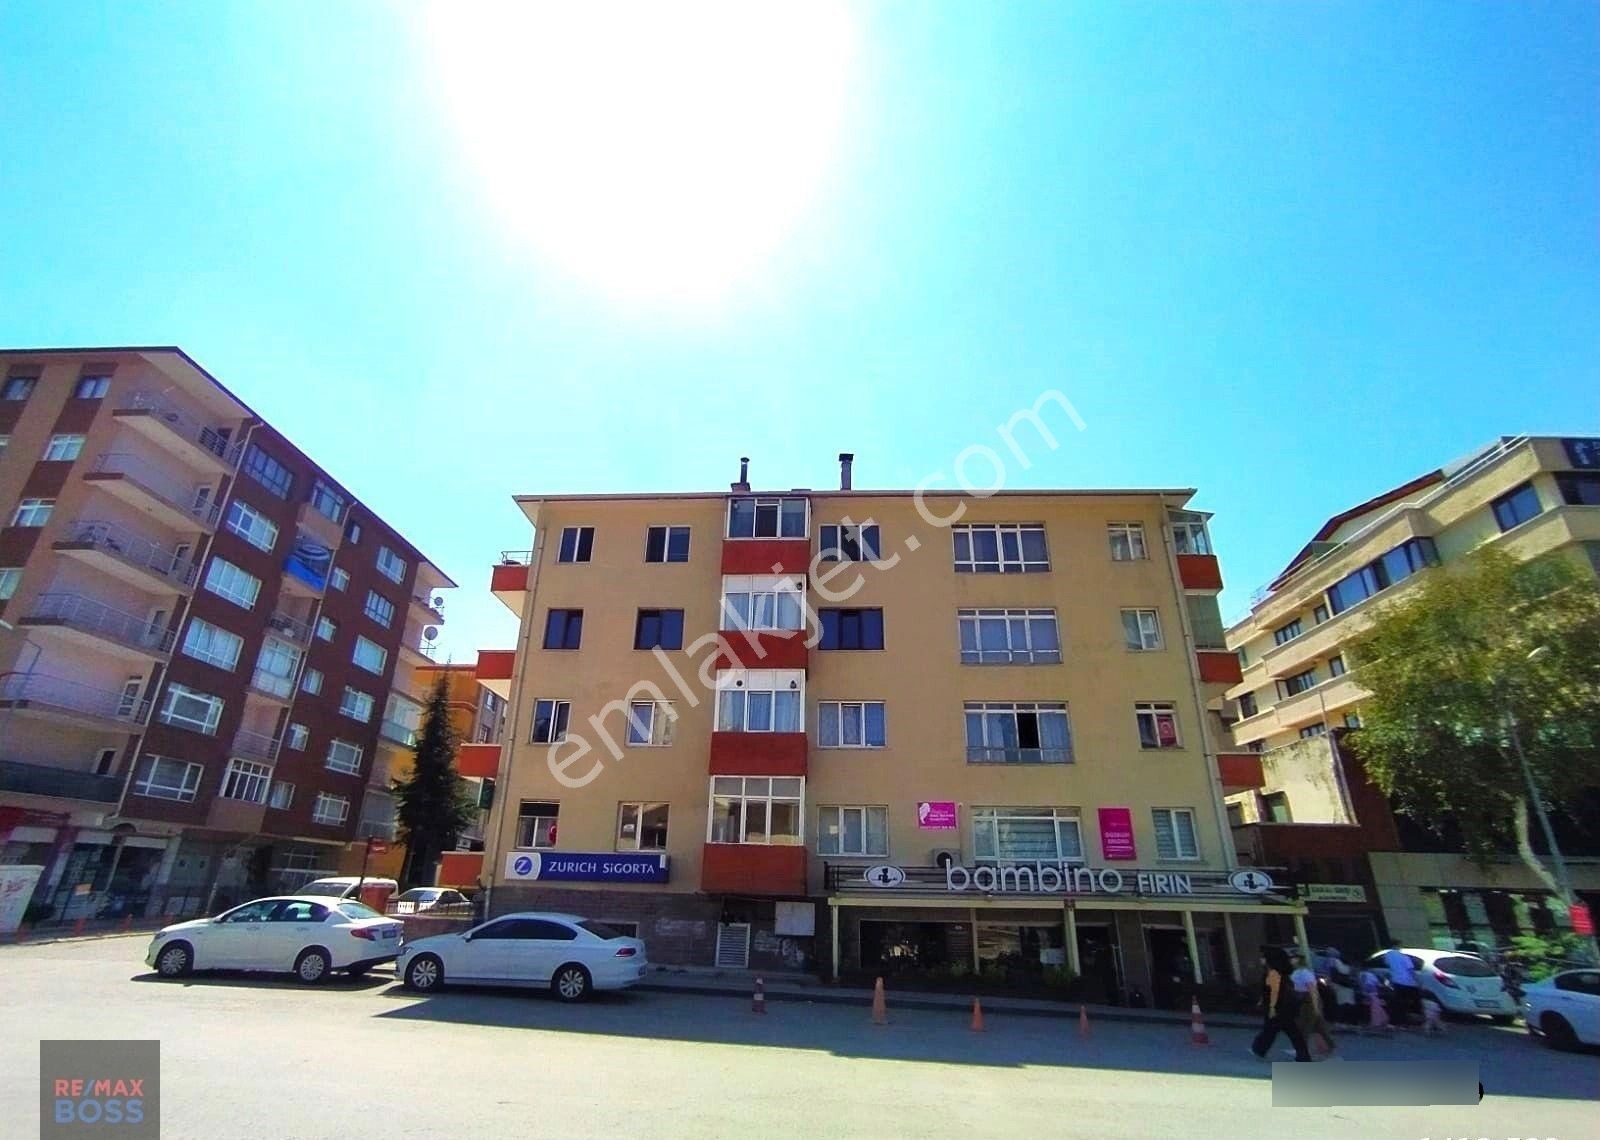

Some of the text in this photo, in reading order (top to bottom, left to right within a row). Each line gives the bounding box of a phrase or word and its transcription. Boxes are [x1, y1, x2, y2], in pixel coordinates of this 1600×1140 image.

[549, 861, 597, 873] ZURICH
[945, 858, 1193, 894] bambino FIRIN
